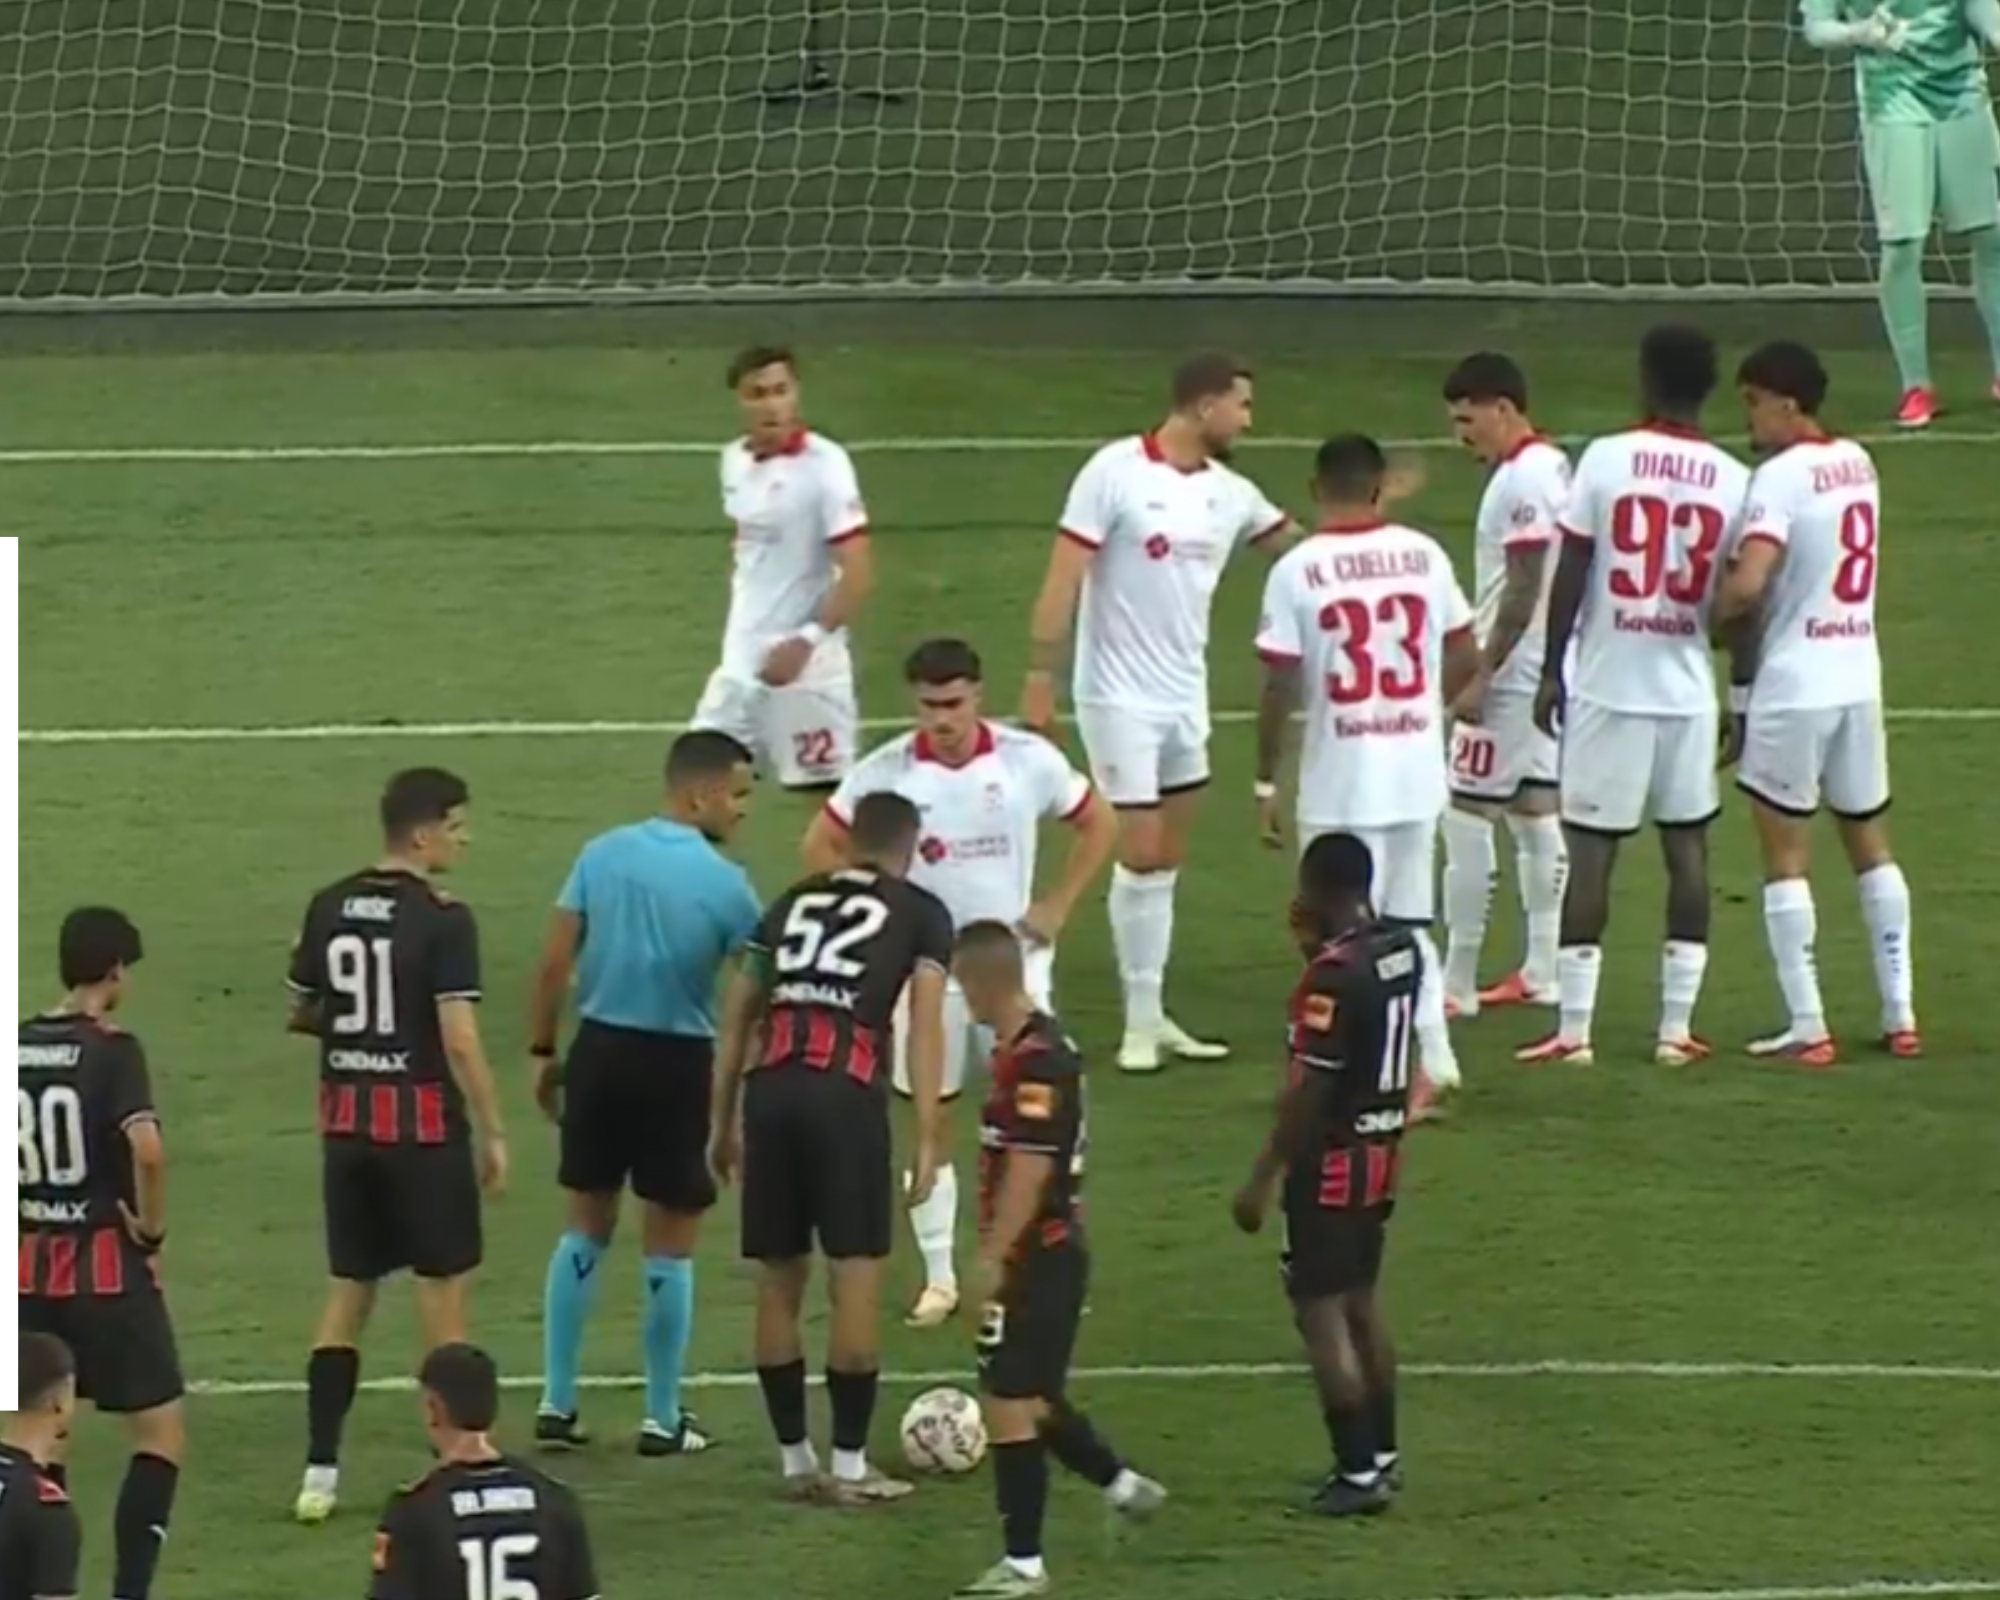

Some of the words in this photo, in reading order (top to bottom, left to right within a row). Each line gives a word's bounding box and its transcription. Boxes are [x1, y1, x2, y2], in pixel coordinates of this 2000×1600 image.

[1632, 451, 1717, 489] DIALLO
[1609, 495, 1724, 604] 93
[1832, 501, 1875, 604] 8
[1318, 594, 1427, 705] 33
[794, 728, 834, 767] 22
[1453, 738, 1495, 778] 20
[776, 893, 889, 977] 52
[327, 934, 395, 1035] 91
[1378, 994, 1411, 1092] 11
[457, 1534, 541, 1600] 16
